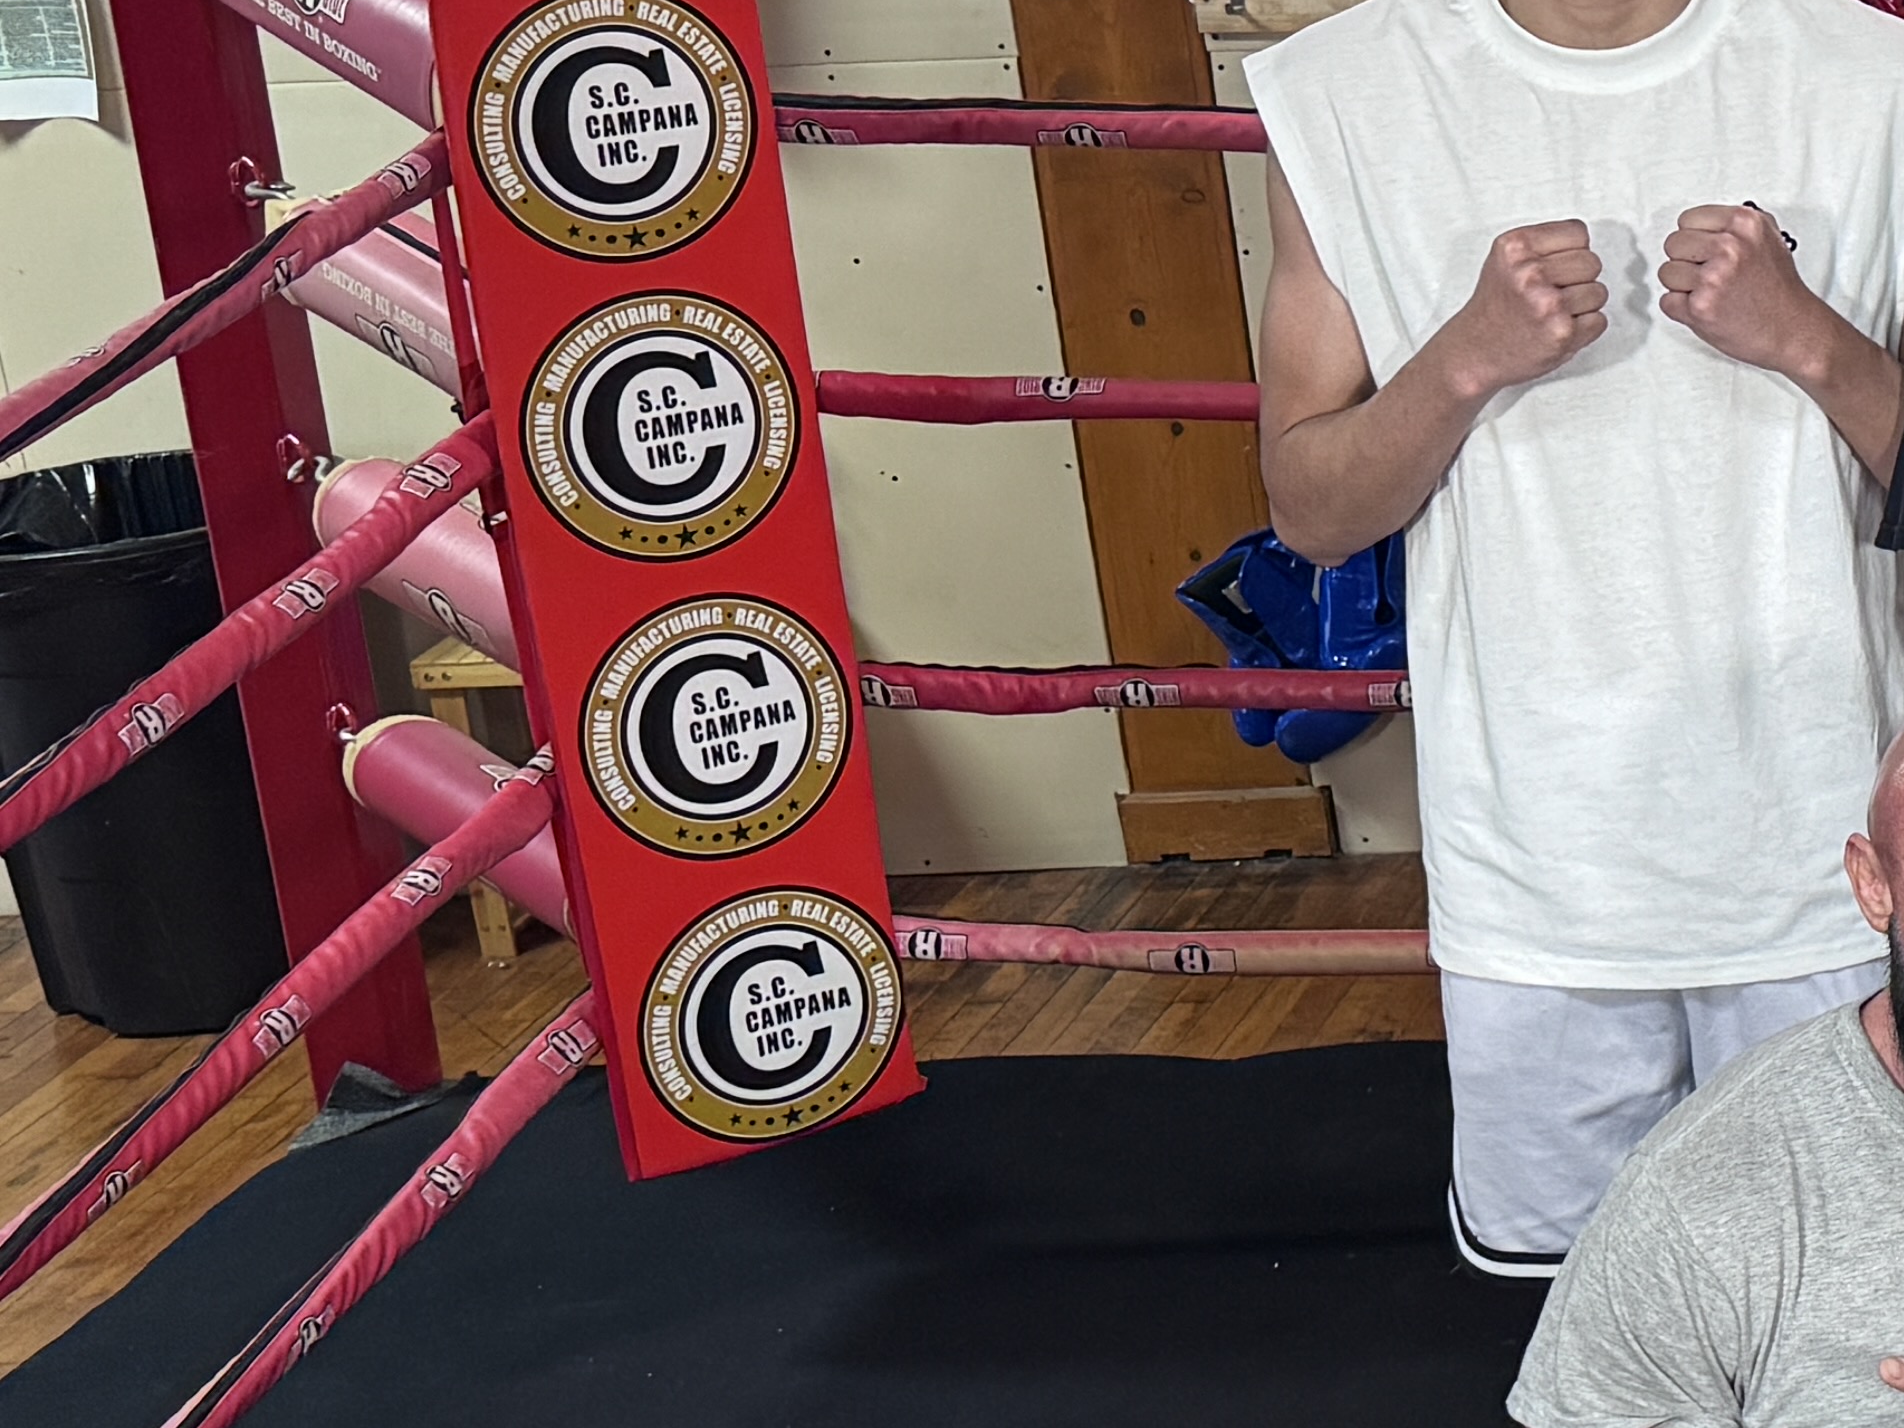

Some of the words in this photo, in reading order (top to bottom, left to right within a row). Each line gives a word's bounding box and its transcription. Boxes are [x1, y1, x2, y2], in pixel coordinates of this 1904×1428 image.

[322, 33, 379, 82] BOXING
[483, 91, 526, 201] CONSULTING
[636, 0, 679, 31] REAL
[676, 20, 728, 76] ESTATE
[717, 82, 744, 175] LICENSING
[589, 82, 639, 110] S.C.
[585, 103, 699, 141] CAMPANA
[597, 139, 647, 168] INC.
[682, 305, 721, 334] REAL
[542, 302, 671, 393] MANUFACTURING
[721, 322, 772, 374] ESTATE
[634, 402, 744, 443] CAMPANA
[637, 385, 687, 413] S.C.
[762, 379, 788, 470] LICENSING
[534, 401, 580, 508] CONSULTING
[646, 441, 695, 470] INC.
[734, 607, 773, 635] REAL
[600, 607, 723, 701] MANUFACTURING
[772, 621, 823, 672] ESTATE
[689, 699, 797, 744] CAMPANA
[691, 686, 739, 715] S.C.
[814, 676, 840, 764] LICENSING
[592, 709, 636, 812] CONSULTING
[701, 740, 749, 770] INC.
[790, 899, 830, 924] REAL
[828, 911, 877, 958] ESTATE
[659, 899, 779, 996] MANUFACTURING
[745, 986, 852, 1033] CAMPANA
[748, 976, 795, 1005] S.C.
[869, 962, 895, 1047] LICENSING
[651, 1004, 694, 1102] CONSULTING
[757, 1028, 803, 1057] INC.
